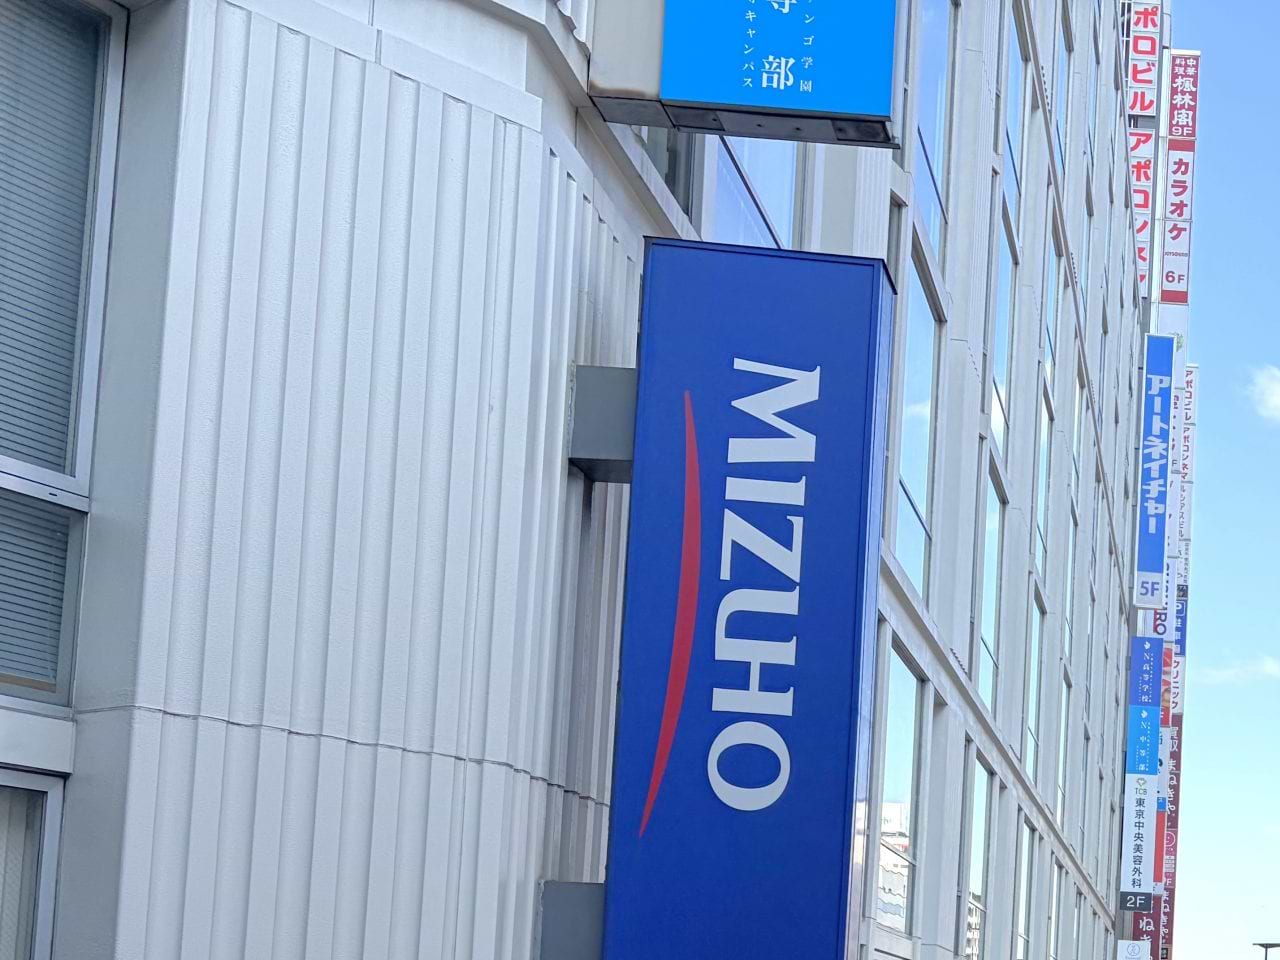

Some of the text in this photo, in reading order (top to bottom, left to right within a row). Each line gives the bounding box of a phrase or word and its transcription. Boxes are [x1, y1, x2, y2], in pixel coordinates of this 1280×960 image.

[742, 0, 757, 88] キャンパス
[799, 0, 815, 93] ンゴ学園
[1171, 127, 1193, 136] 9F
[1168, 158, 1190, 241] カラオケ
[1165, 271, 1185, 284] 6F
[1142, 374, 1171, 534] アートネイチャー
[707, 357, 821, 812] MIZUHO
[1138, 580, 1160, 598] 5F
[1130, 797, 1146, 889] 東京中央美容外科
[1126, 895, 1146, 908] 2F
